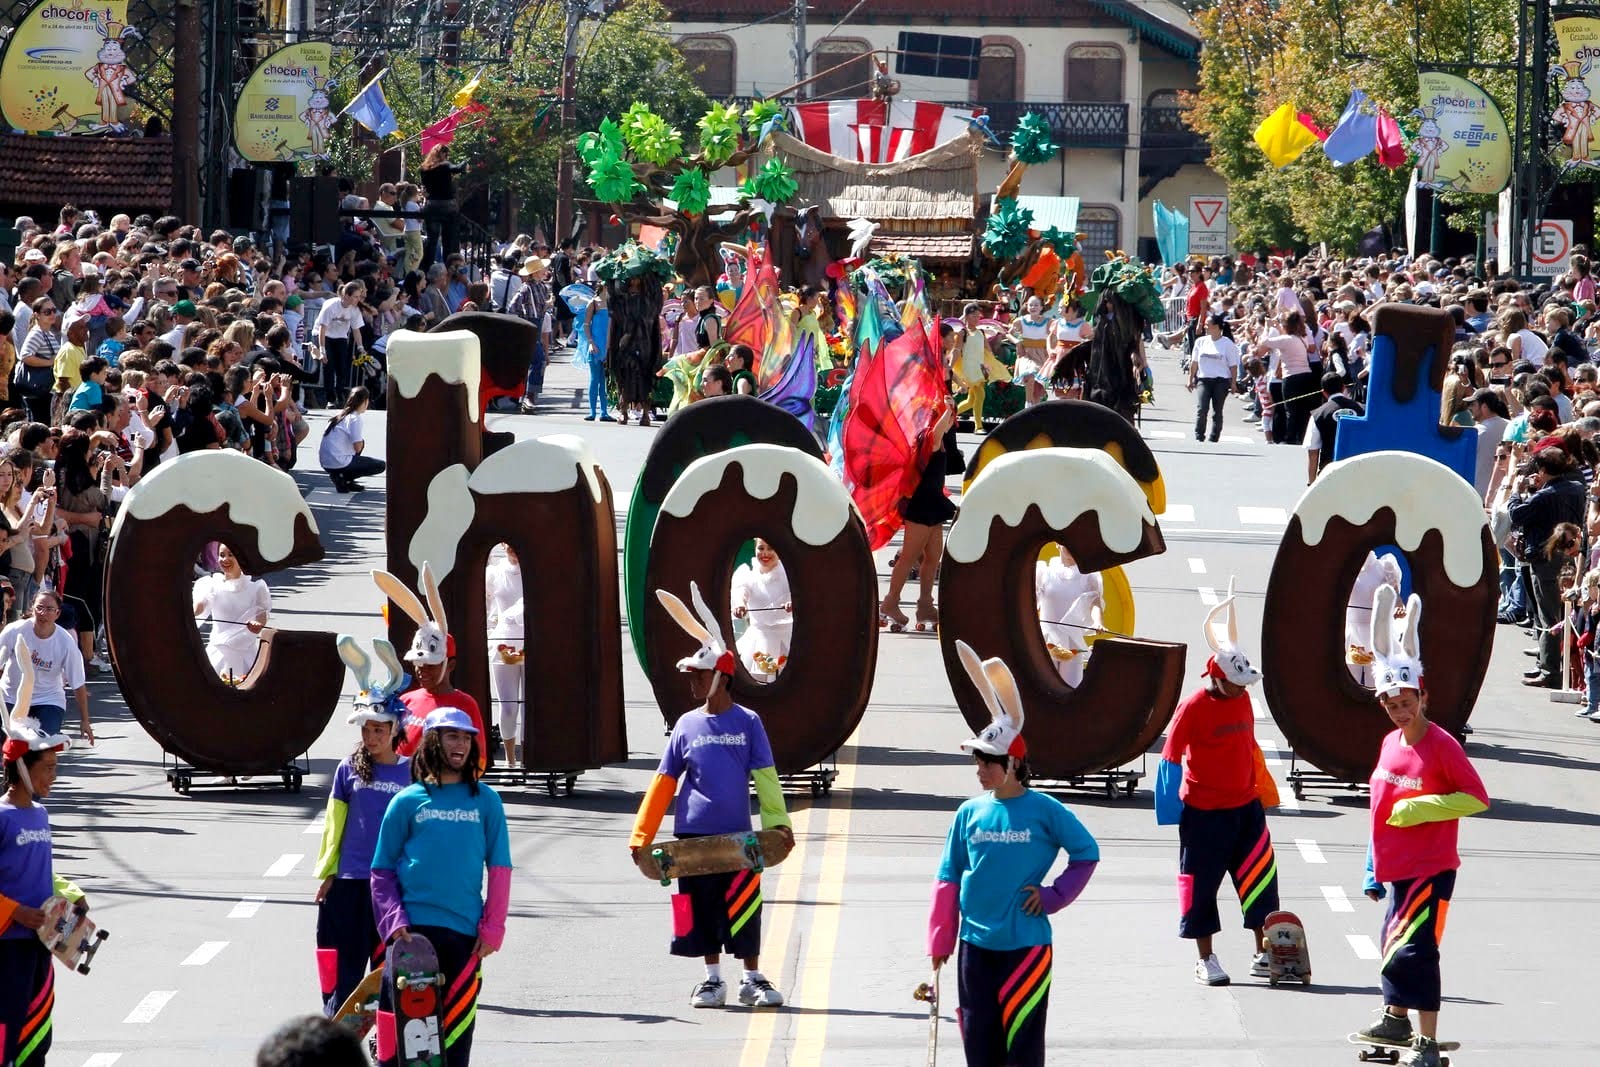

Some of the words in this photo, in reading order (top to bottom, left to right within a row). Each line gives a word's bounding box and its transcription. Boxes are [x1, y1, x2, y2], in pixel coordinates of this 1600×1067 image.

[42, 5, 111, 21] chocofest
[1575, 45, 1600, 59] cho
[264, 65, 317, 77] chocofest
[1431, 95, 1486, 109] chocofest
[1453, 130, 1498, 141] SEBRAE
[1541, 231, 1556, 255] E
[692, 732, 747, 748] chocofest
[416, 807, 480, 823] chocofest
[970, 826, 1031, 844] chocofest
